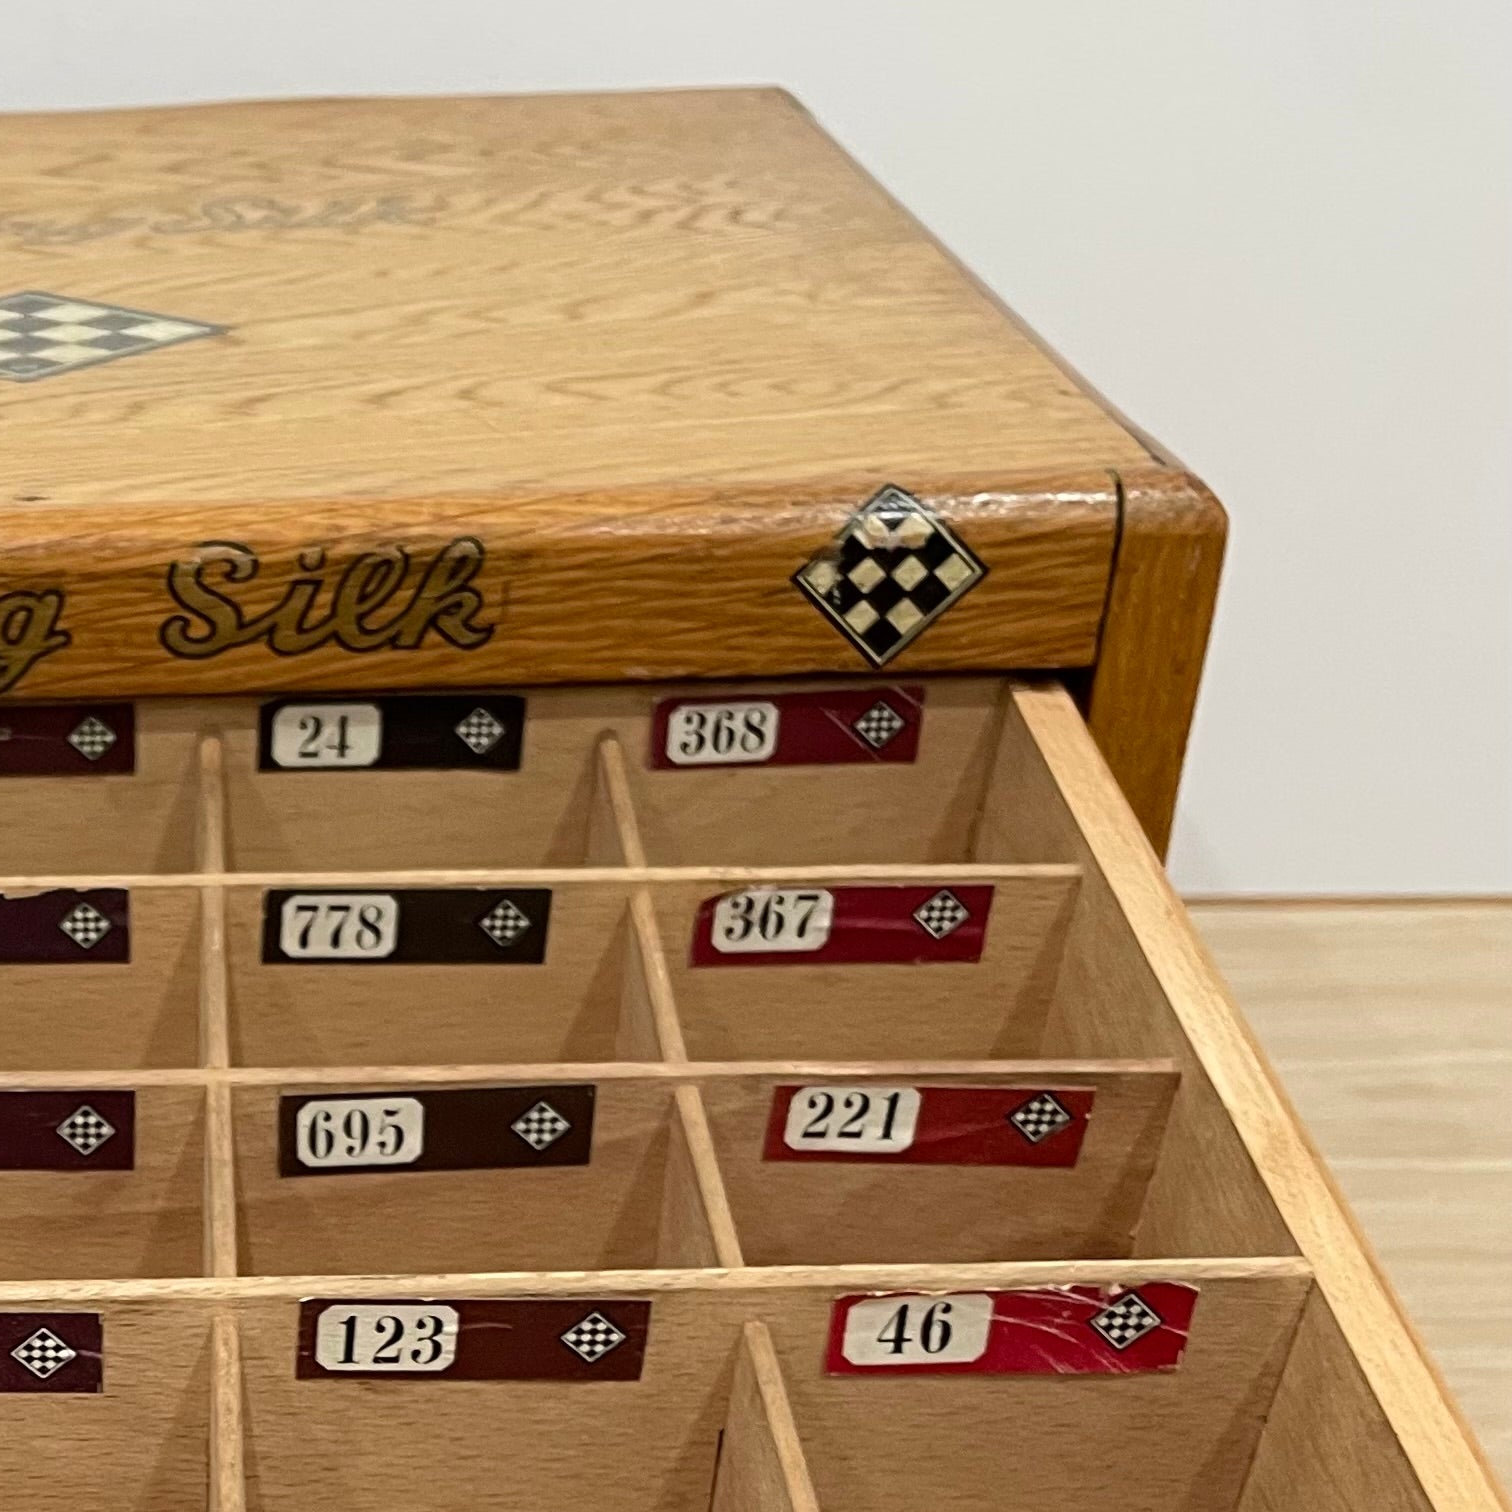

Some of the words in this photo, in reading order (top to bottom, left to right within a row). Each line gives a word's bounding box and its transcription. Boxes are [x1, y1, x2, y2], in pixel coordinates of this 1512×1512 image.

[159, 536, 497, 661] Silk
[298, 714, 350, 759] 24
[678, 706, 769, 756] 368
[295, 904, 383, 950] 778
[724, 894, 820, 942] 367
[307, 1109, 405, 1159] 695
[801, 1091, 901, 1140] 221
[337, 1315, 444, 1365] 123
[876, 1303, 952, 1355] 46
